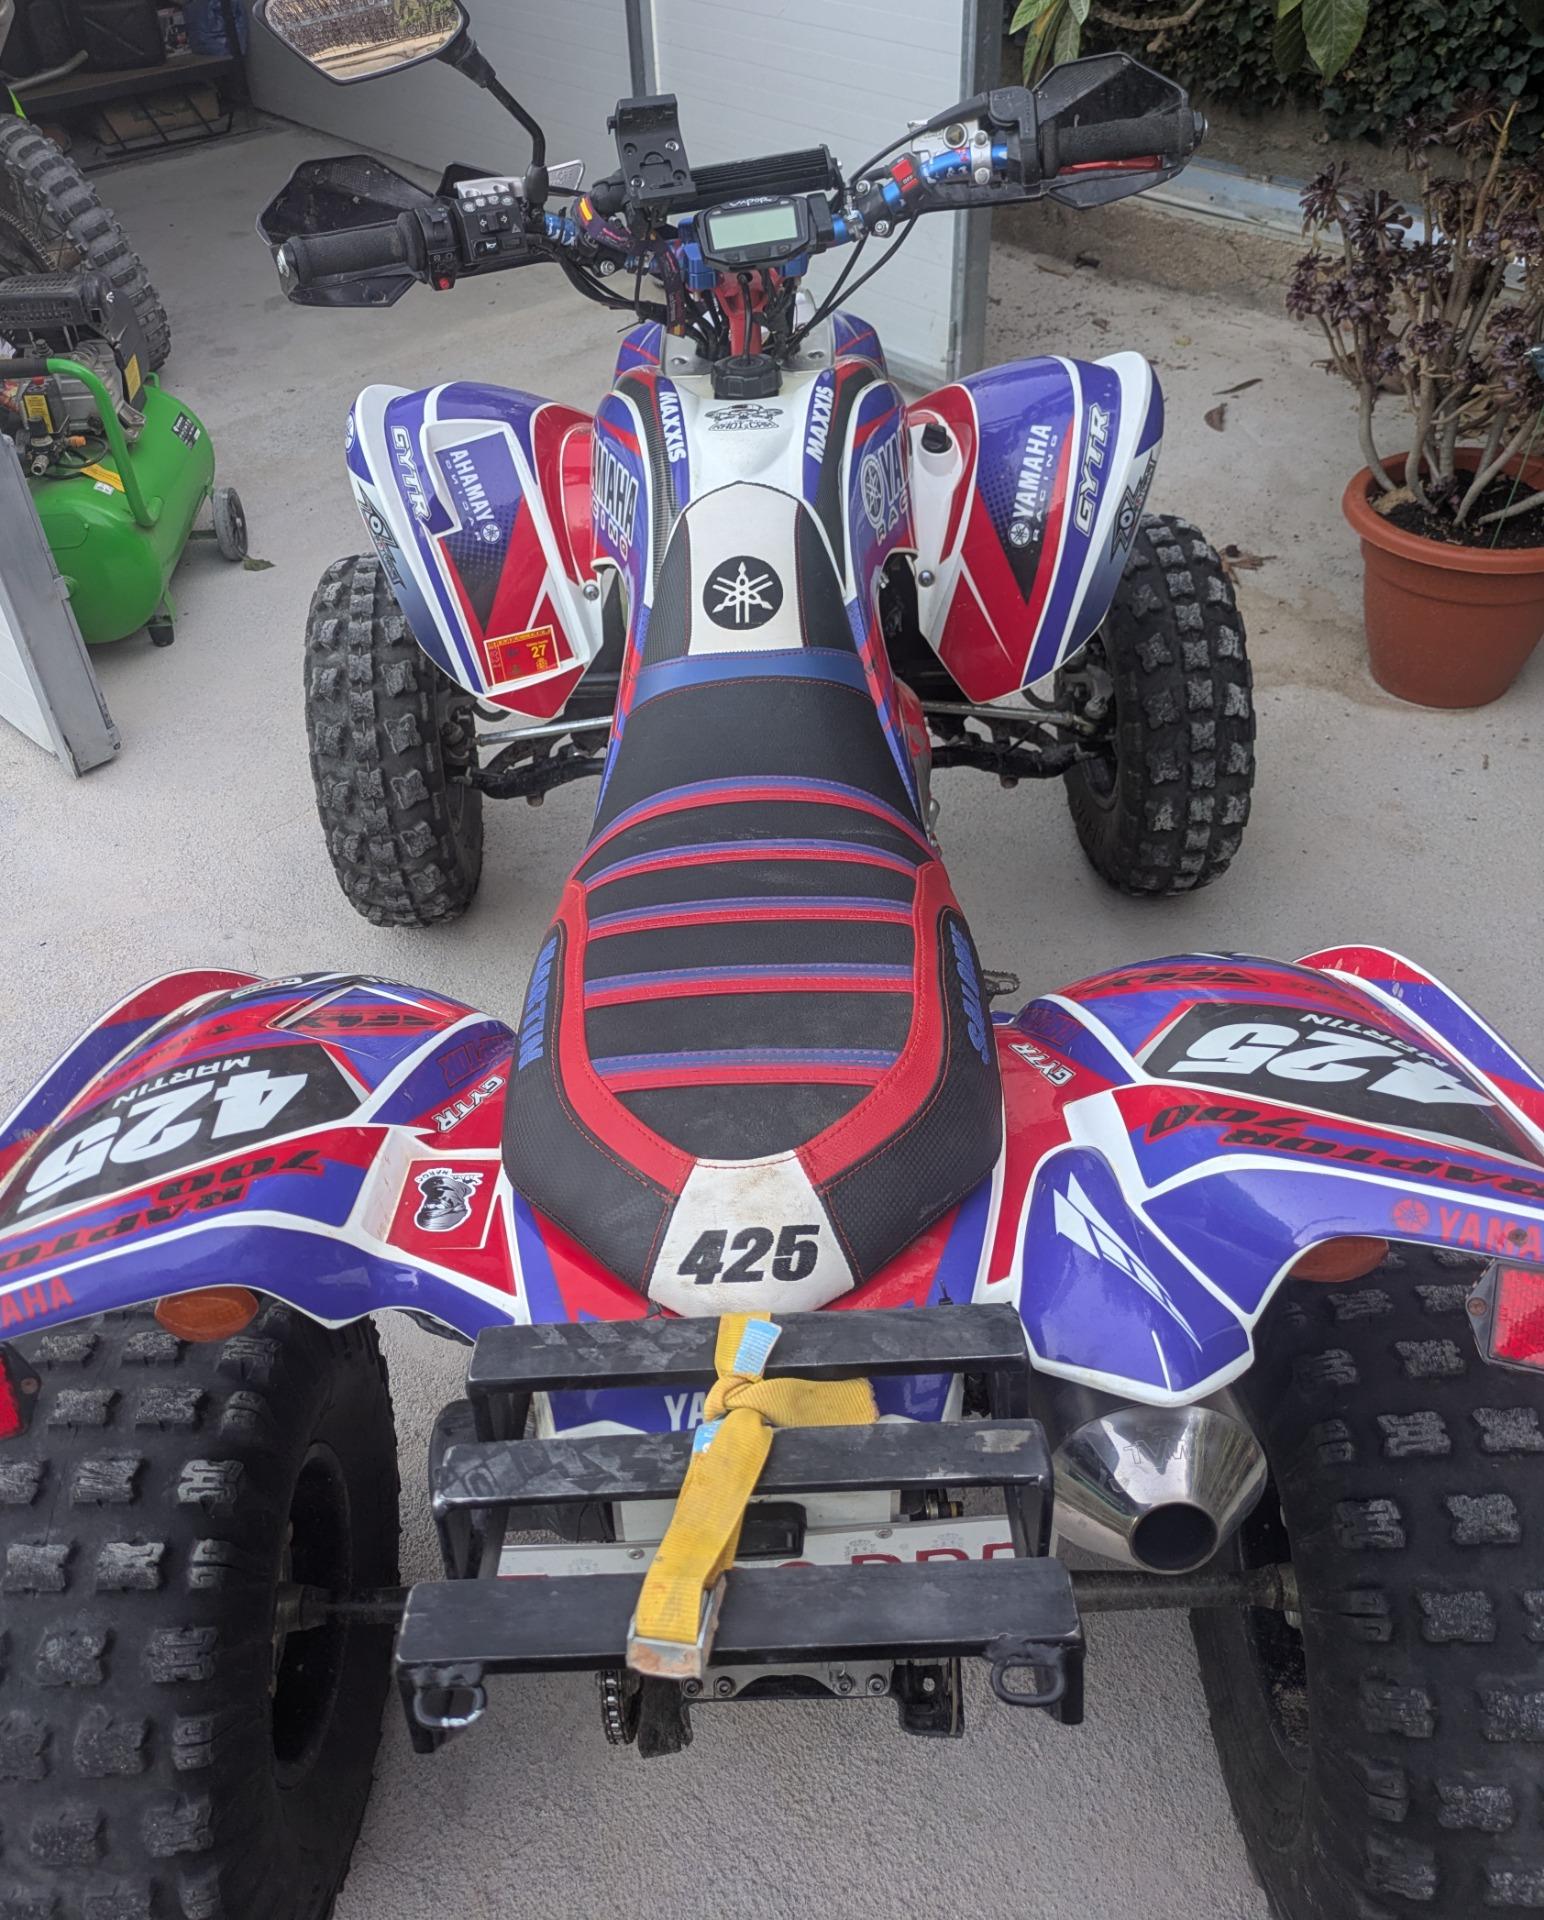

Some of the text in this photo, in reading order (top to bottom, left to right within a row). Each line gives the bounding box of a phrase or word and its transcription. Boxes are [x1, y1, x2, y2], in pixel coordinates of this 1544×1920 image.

[660, 391, 686, 463] MAXXIS
[806, 386, 835, 464] MAXXIS
[391, 425, 432, 520] GYTR
[1012, 424, 1052, 518] YAMAHA
[1032, 435, 1058, 542] RACING
[1074, 403, 1110, 537] GYTR
[530, 643, 547, 659] 27
[1008, 1042, 1077, 1086] GYTR
[1168, 1023, 1496, 1106] 425
[1299, 1013, 1448, 1067] MARTIN
[113, 1055, 252, 1110] MARTIN
[432, 1074, 505, 1133] GYTR
[18, 1070, 308, 1214] 425
[1149, 1105, 1298, 1138] 700
[158, 1149, 321, 1201] 700
[679, 1224, 820, 1286] 425
